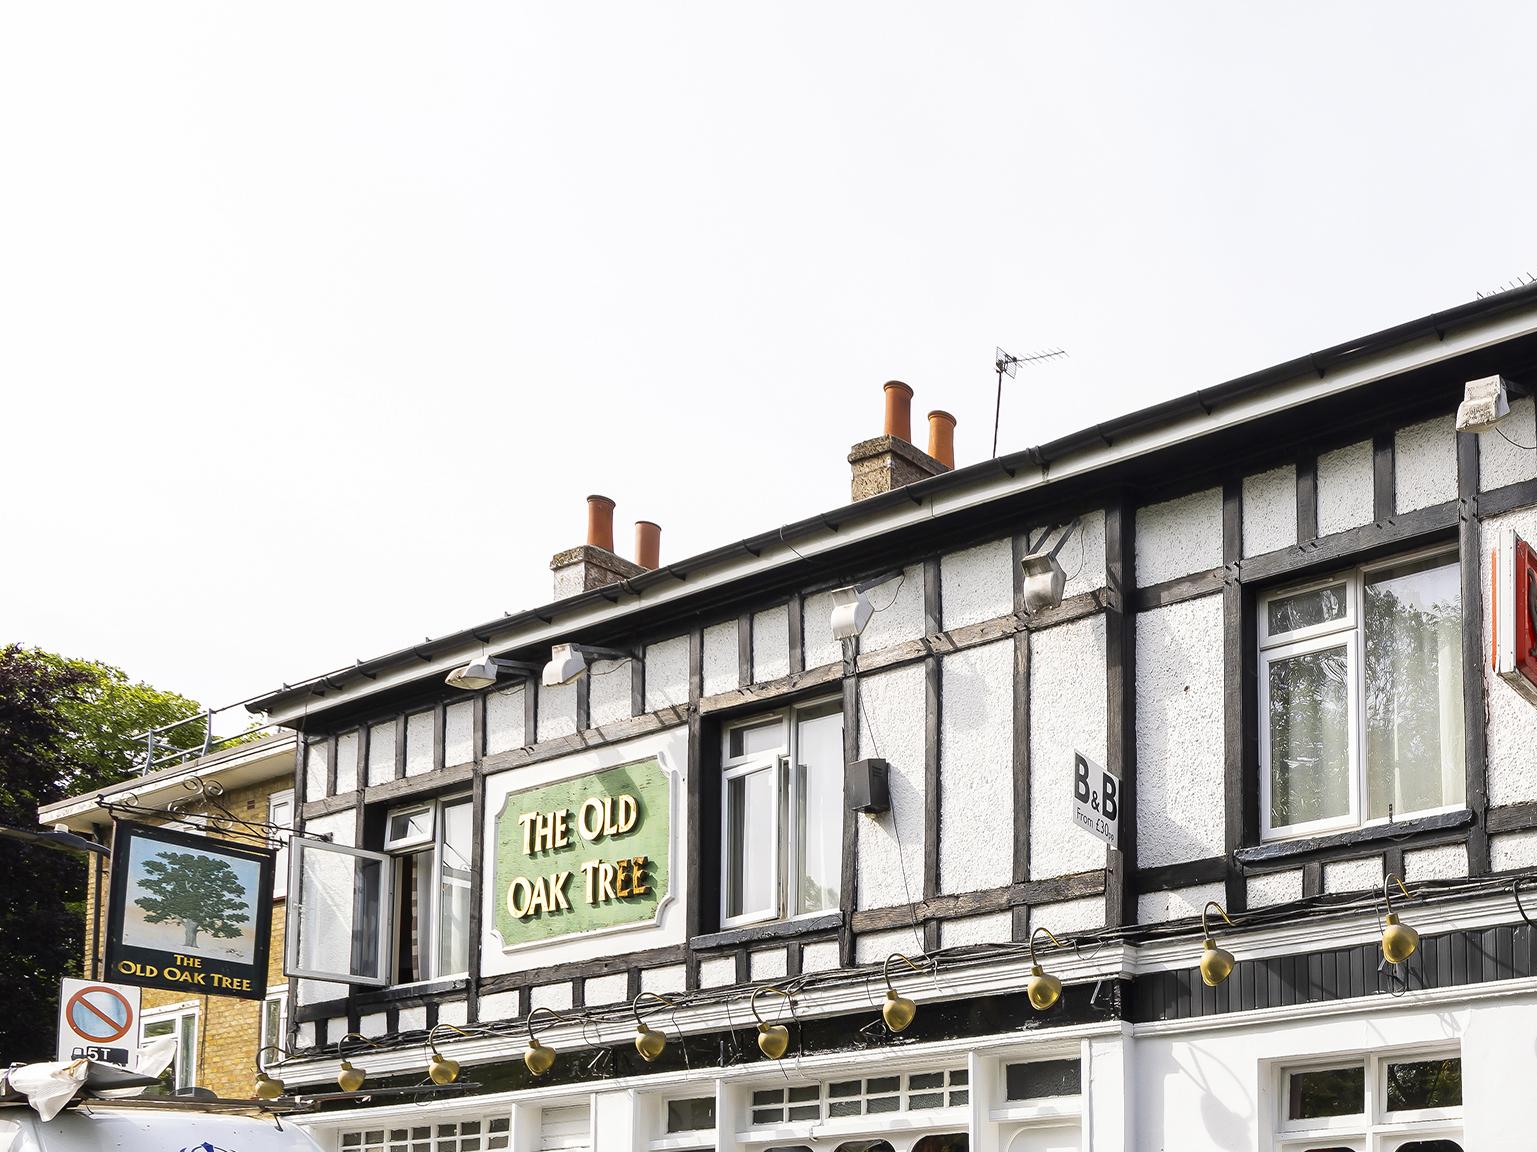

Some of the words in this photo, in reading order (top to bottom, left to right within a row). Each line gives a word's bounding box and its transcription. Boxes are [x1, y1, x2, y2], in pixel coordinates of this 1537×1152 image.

[518, 808, 570, 855] THE
[577, 794, 637, 841] OLD
[1076, 806, 1094, 829] From
[506, 871, 570, 919] OAK
[580, 856, 648, 904] TREE
[118, 960, 158, 978] OLD
[163, 967, 206, 985] OAK
[210, 973, 252, 991] TREE
[173, 954, 202, 969] THE
